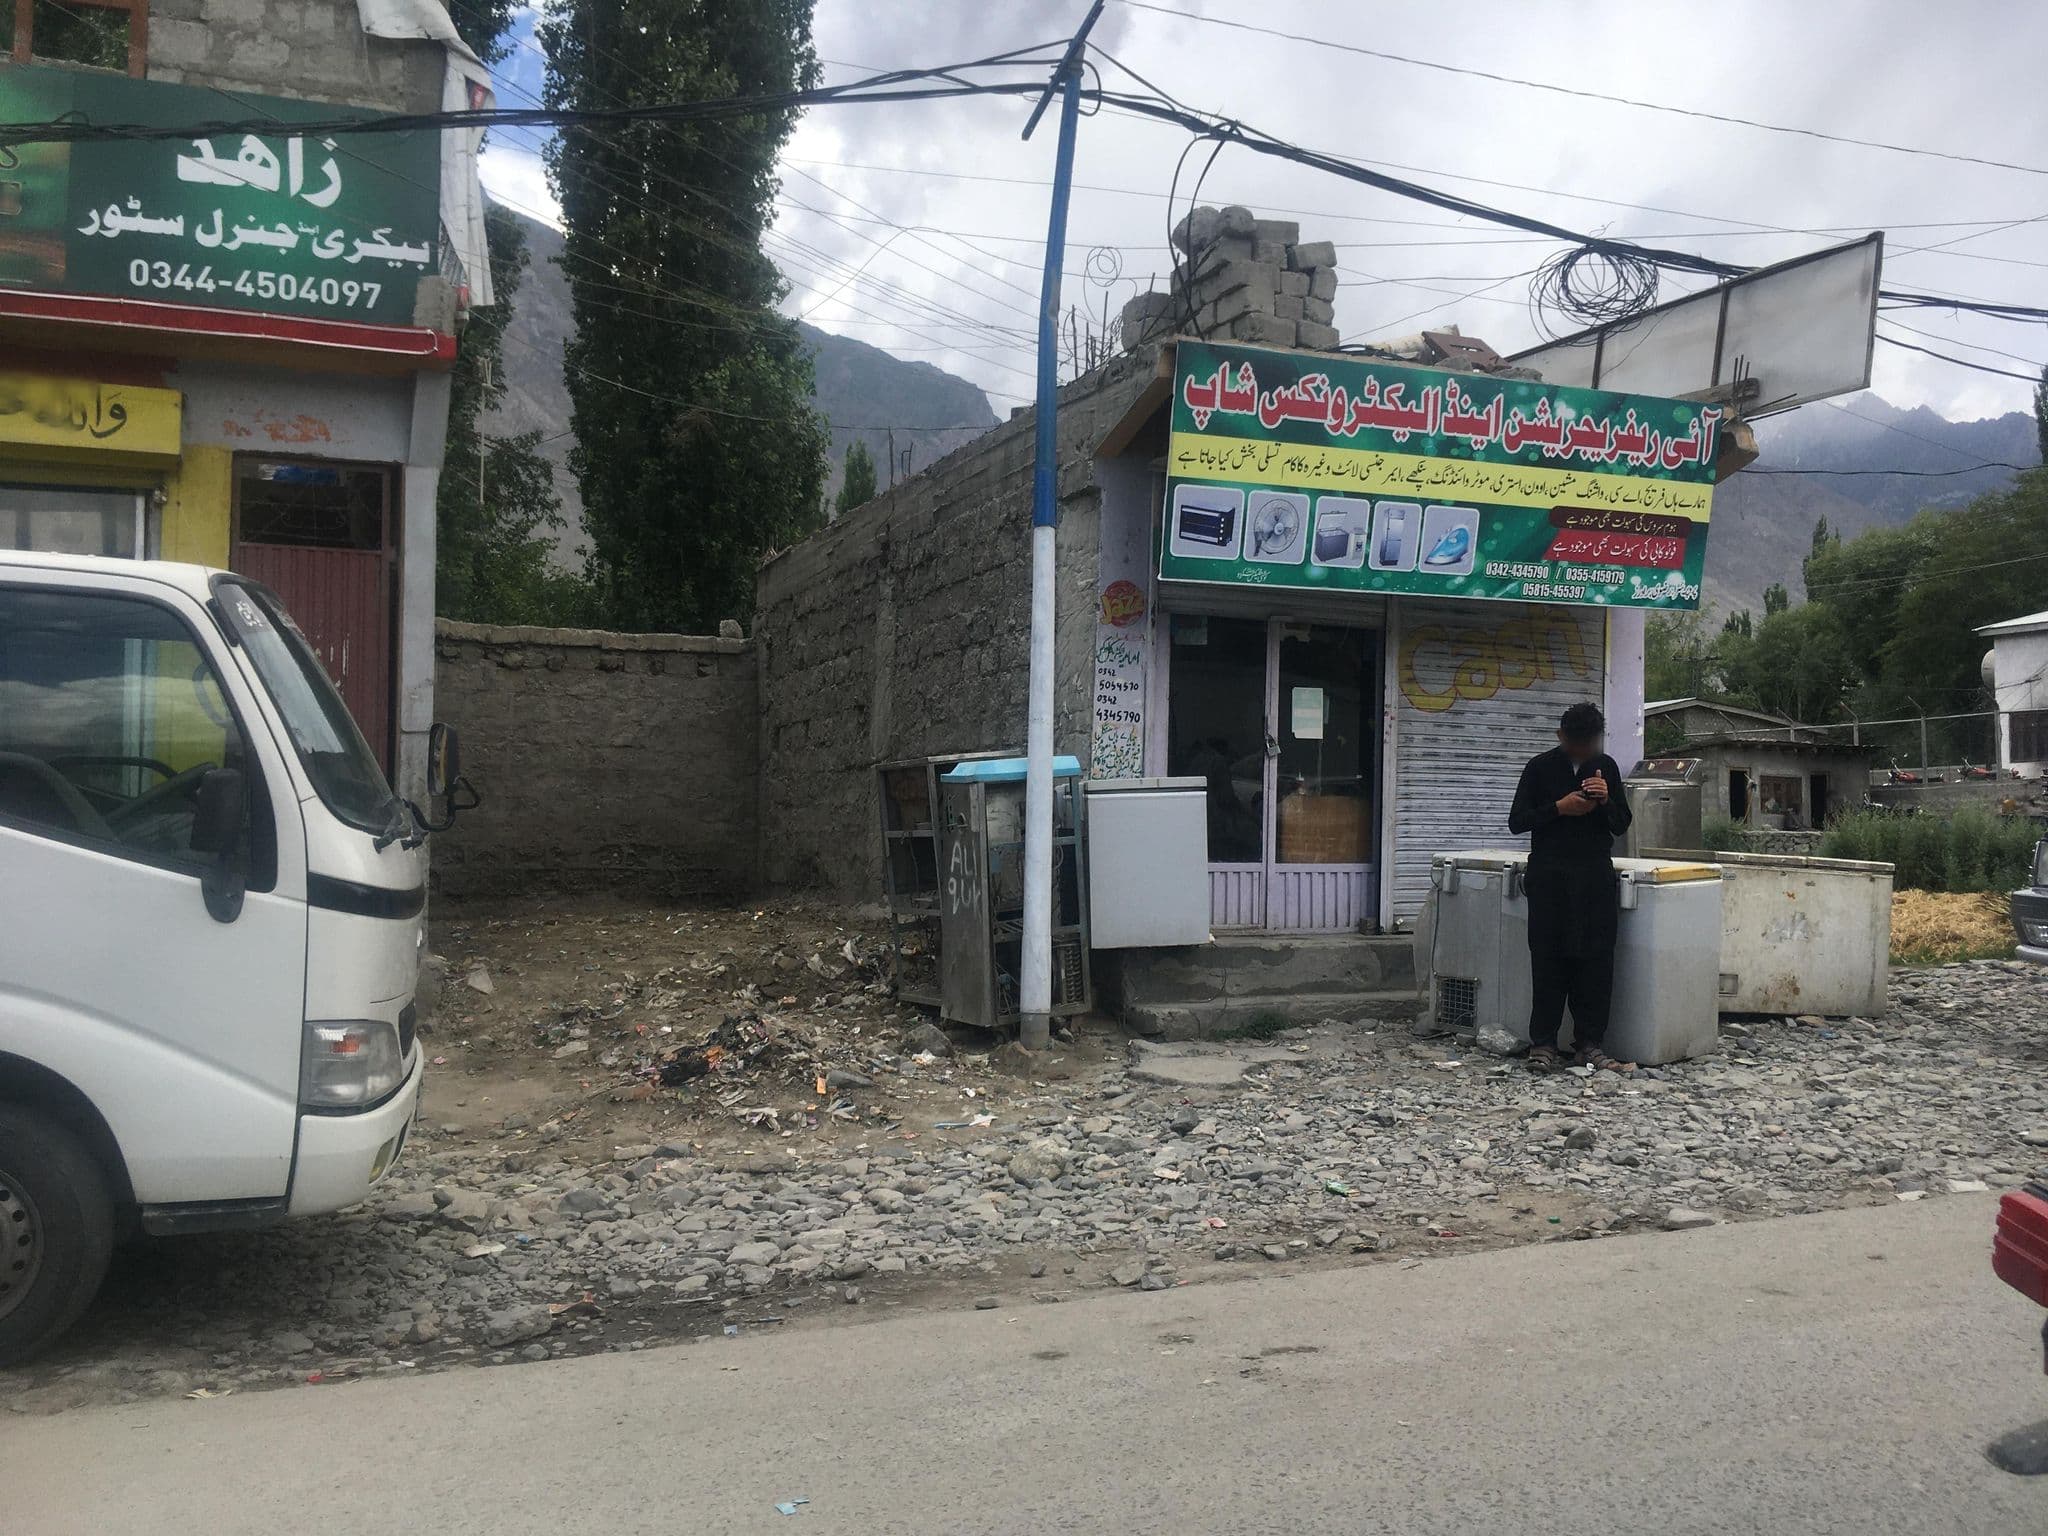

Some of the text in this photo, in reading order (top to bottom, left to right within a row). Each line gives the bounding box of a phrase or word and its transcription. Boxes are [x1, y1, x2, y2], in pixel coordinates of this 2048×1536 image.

[77, 195, 184, 238] سٹور
[195, 208, 299, 255] جنرل
[312, 228, 430, 270] بیکری
[130, 258, 382, 309] 0344-4504097
[1183, 361, 1722, 470] آئی ریفریجریشن اینڈ الیکٹرونکس شاپ
[1178, 447, 1197, 470] ہے
[1332, 459, 1359, 478] لائٹ
[1470, 466, 1490, 489] موٹر
[1678, 496, 1706, 510] ہمارے
[1486, 562, 1549, 580] 0342-4345790
[1565, 568, 1625, 585] 0355-4159179
[1522, 582, 1586, 599] 05815-455397
[1096, 694, 1117, 705] 0342
[1096, 708, 1141, 723] 4345790
